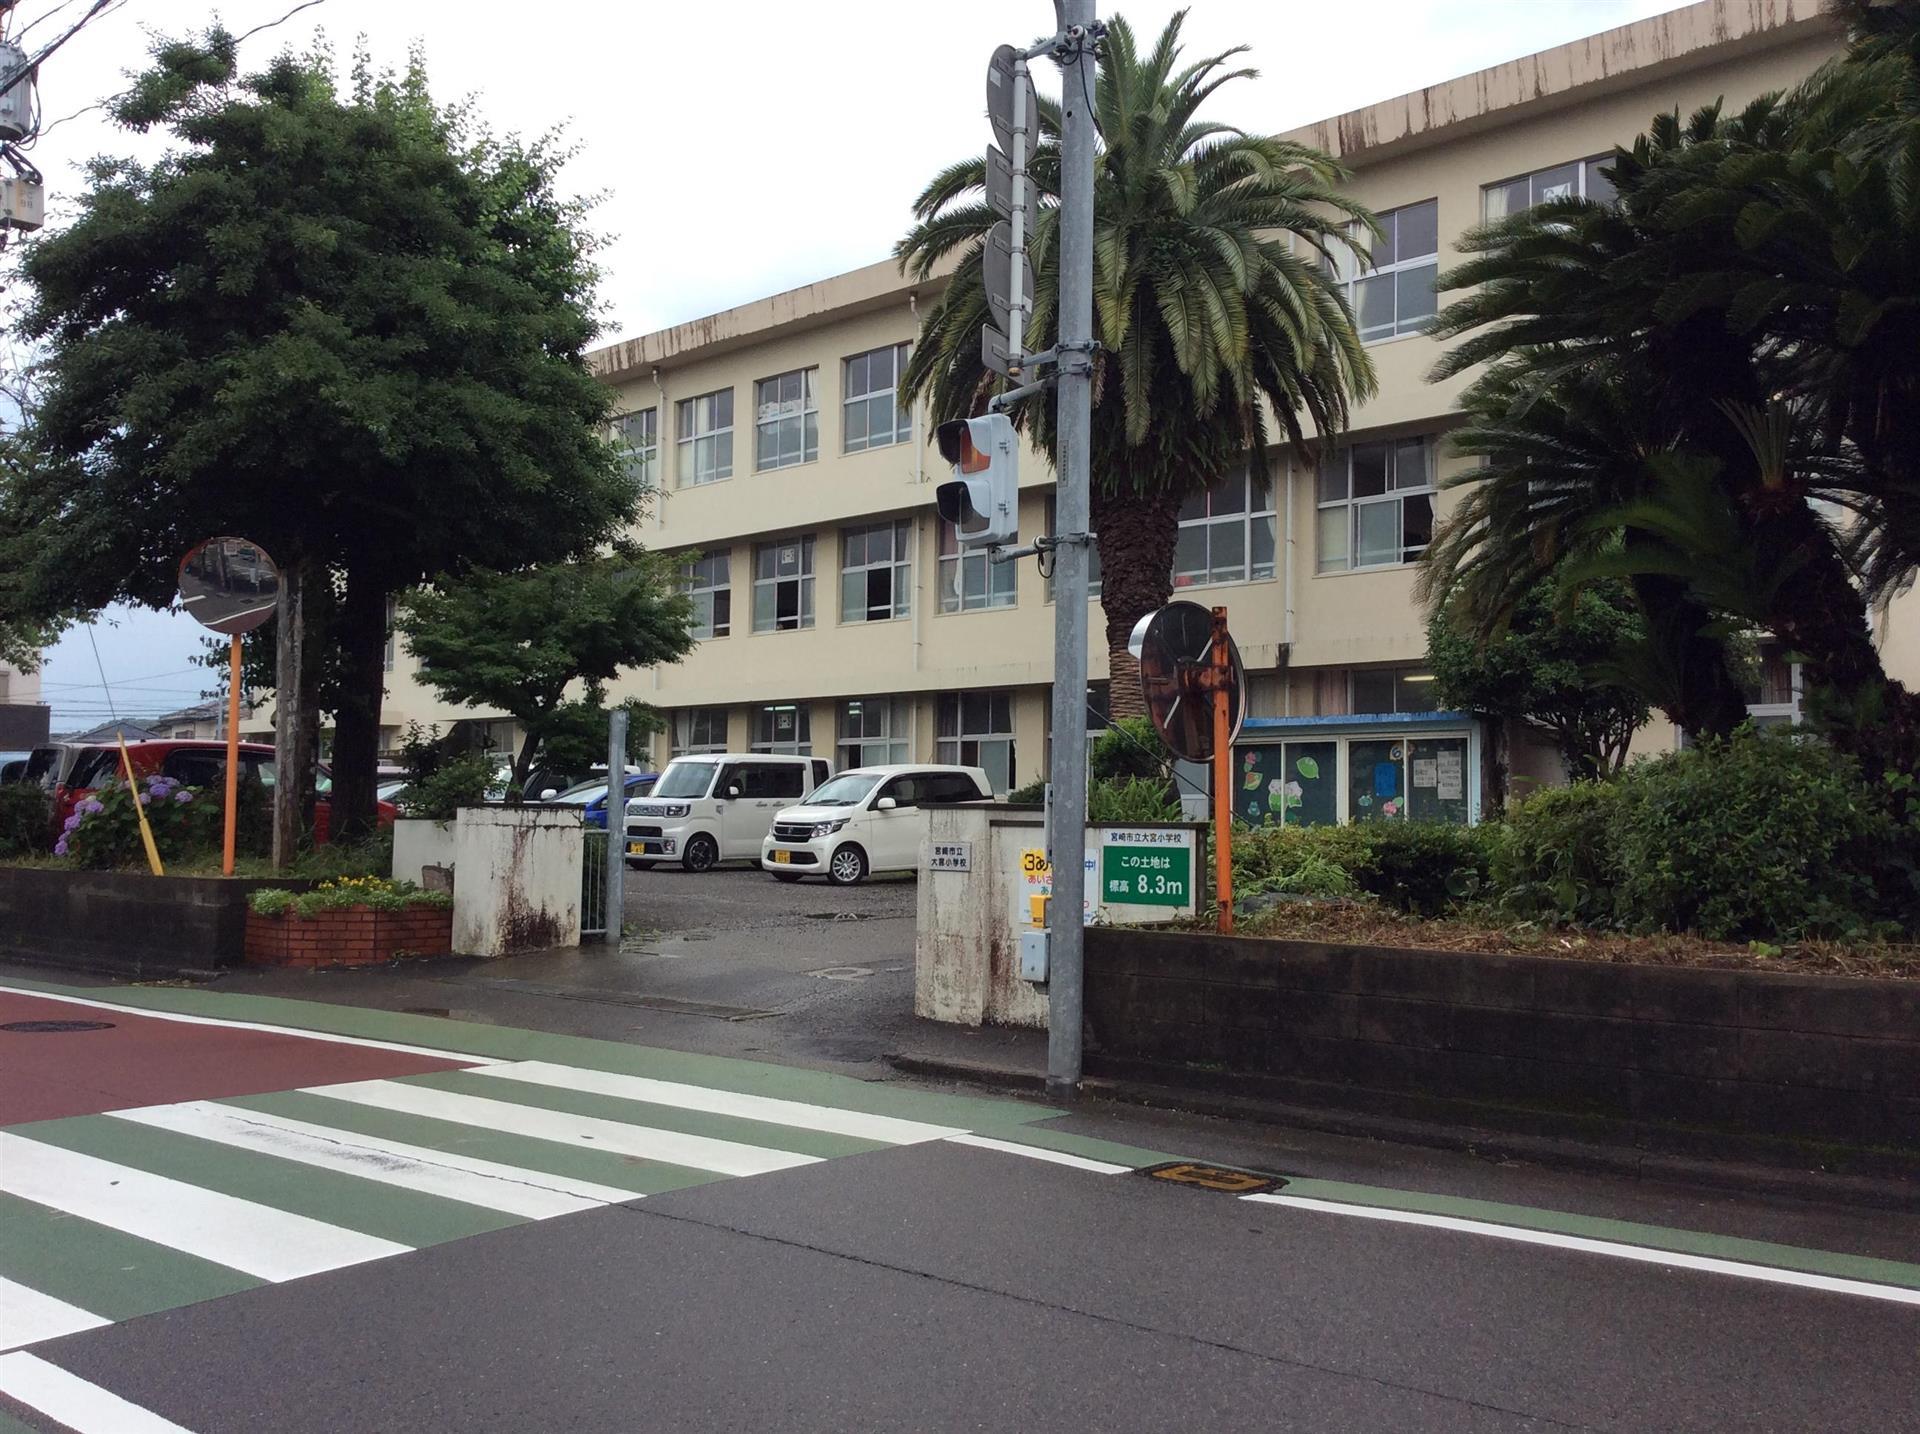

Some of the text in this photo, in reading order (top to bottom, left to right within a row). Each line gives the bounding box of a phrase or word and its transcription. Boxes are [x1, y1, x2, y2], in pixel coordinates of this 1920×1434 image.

[1110, 831, 1183, 844] 宮崎市立大宮小学校
[1024, 853, 1053, 872] 3あ
[1120, 856, 1171, 869] この土地は
[1109, 874, 1183, 895] 標高 8.3m
